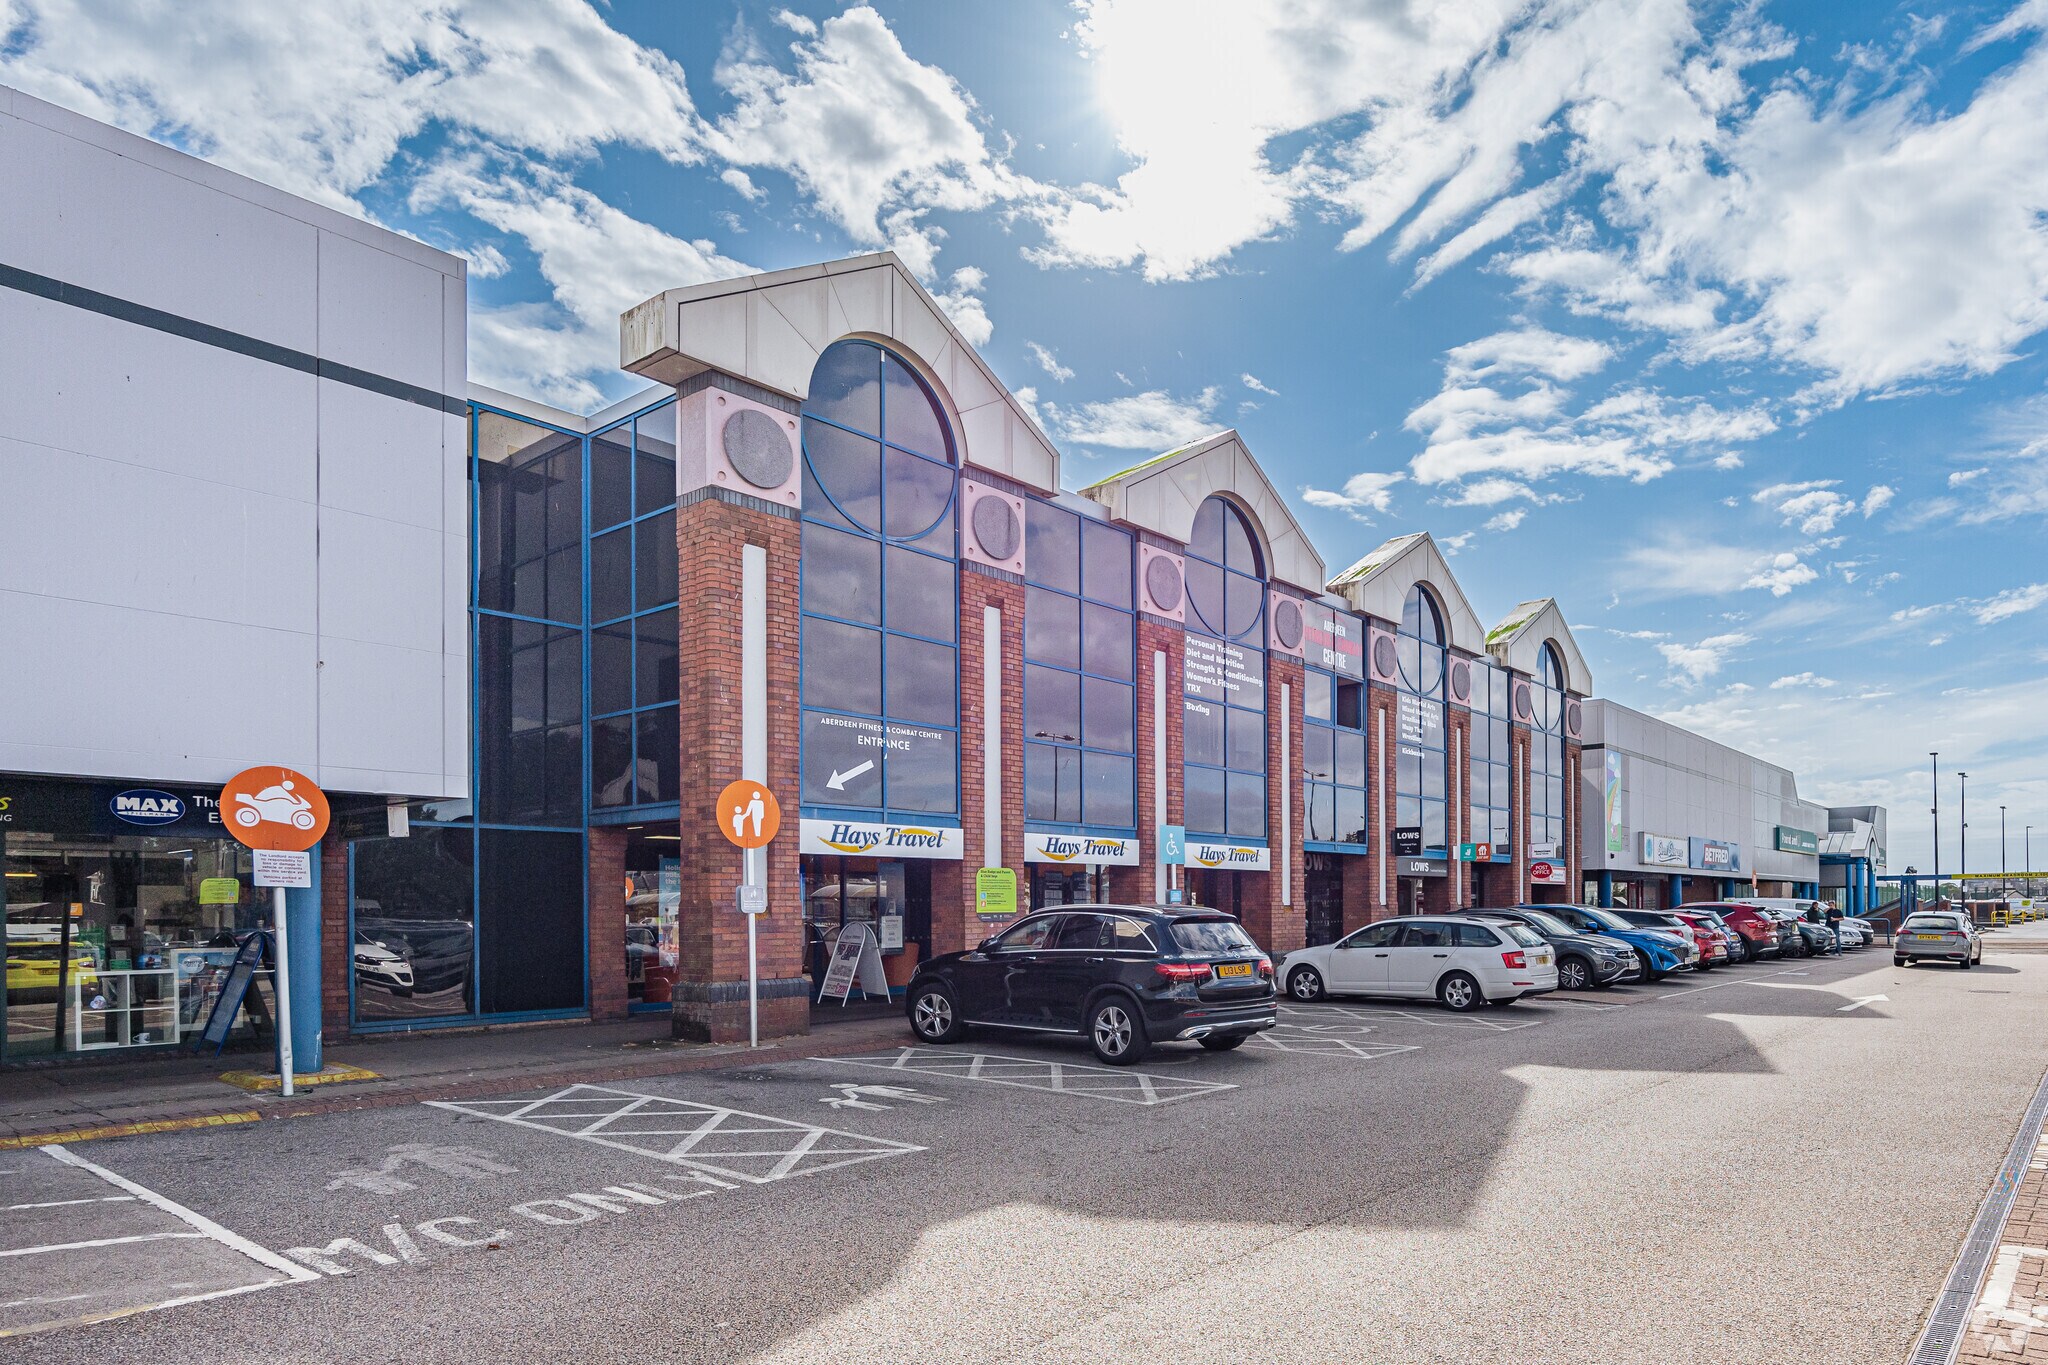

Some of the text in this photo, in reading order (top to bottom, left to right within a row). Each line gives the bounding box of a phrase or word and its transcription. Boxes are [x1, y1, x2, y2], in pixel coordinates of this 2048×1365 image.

[1186, 636, 1243, 660] Personal Training
[1186, 648, 1244, 670] Diet and Nutrition
[1323, 648, 1346, 668] CENTRE
[1186, 660, 1263, 687] Strength & Conditioning
[1186, 671, 1216, 686] Women's
[1186, 683, 1201, 693] TRX
[1186, 702, 1210, 716] Boxing
[820, 717, 858, 728] ABERDEEN
[858, 722, 883, 732] FITNESS
[891, 727, 917, 736] COMBAT
[918, 731, 942, 740] CENTRE
[857, 735, 910, 750] ENTRANCE
[117, 796, 179, 812] MAX
[192, 795, 220, 807] The
[829, 824, 944, 849] Hays Travel
[1045, 837, 1125, 857] Hays Travel
[1200, 846, 1259, 863] Hays Travel
[1704, 846, 1729, 864] BETFRED
[1410, 861, 1430, 872] LOWS
[1235, 966, 1247, 974] LSR
[509, 1170, 741, 1224] ONLY
